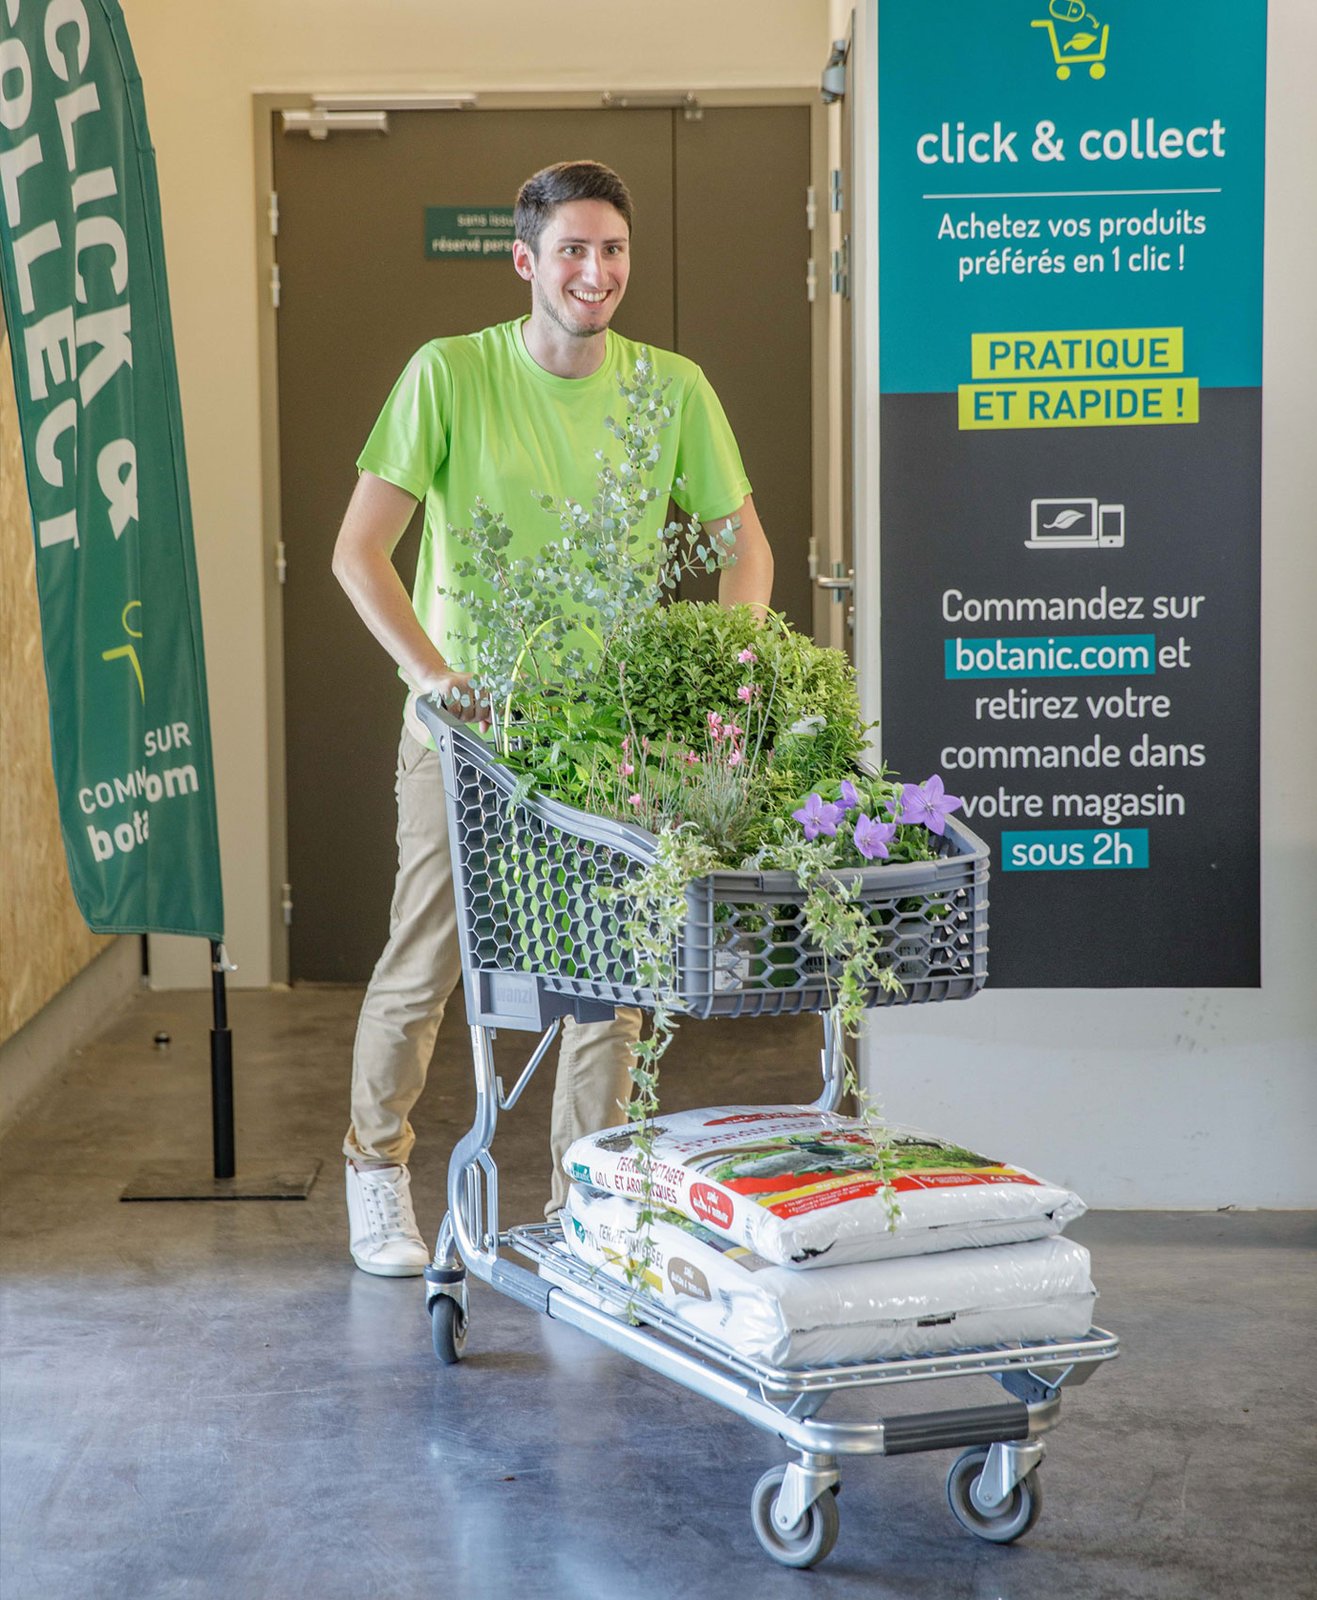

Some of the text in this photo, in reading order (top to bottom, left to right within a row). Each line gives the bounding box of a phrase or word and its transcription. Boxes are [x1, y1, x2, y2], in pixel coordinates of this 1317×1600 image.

[917, 117, 1227, 166] click & collect
[44, 0, 132, 408] CLICK
[457, 213, 487, 228] sans
[432, 235, 481, 253] réservé
[937, 208, 1207, 244] Achetez vos produits
[958, 244, 1186, 283] préférés en 1 clic !
[988, 337, 1171, 372] PRATIQUE
[974, 387, 1186, 422] ET RAPIDE !
[942, 586, 1207, 624] Commandez sur
[955, 637, 1192, 673] botanic.com et
[975, 687, 1172, 721] retirez votre
[144, 721, 192, 757] SUR
[940, 733, 1207, 770] commande dans
[960, 785, 1186, 827] votre magasin
[1011, 832, 1134, 868] sous 2h
[614, 1175, 625, 1191] ET
